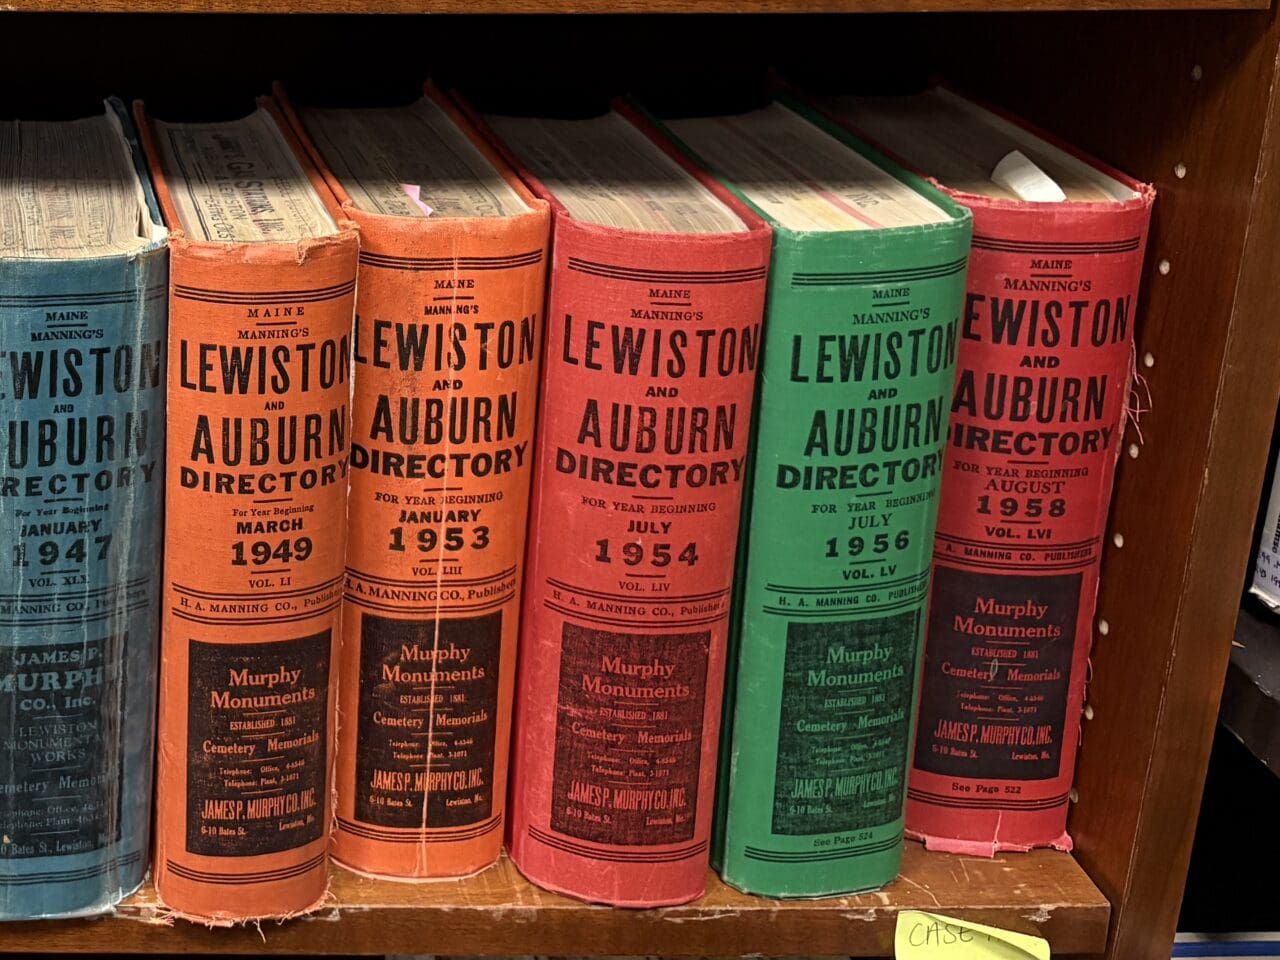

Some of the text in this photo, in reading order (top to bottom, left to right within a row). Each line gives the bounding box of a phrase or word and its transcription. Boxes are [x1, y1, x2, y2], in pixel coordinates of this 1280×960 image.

[631, 309, 703, 321] MANNING'S
[354, 314, 536, 372] LEWISTON
[790, 318, 960, 384] LEWISTON
[951, 368, 1107, 423] AUBURN
[984, 479, 1066, 494] AUGUST
[399, 509, 481, 523] JANUARY
[977, 495, 1065, 517] 1958
[237, 518, 303, 534] MARCH
[628, 520, 671, 534] JULY
[848, 513, 892, 530] JULY
[13, 533, 112, 567] 1947
[389, 526, 489, 552] 1953
[826, 530, 909, 557] 1956
[232, 537, 312, 565] 1949
[596, 539, 699, 567] 1954
[843, 565, 897, 580] VOL. LV
[975, 597, 1048, 619] Murphy
[400, 644, 471, 662] Murphy
[582, 674, 689, 701] Monuments
[210, 686, 316, 712] Monuments
[203, 731, 318, 756] Cemetery Memorials
[31, 748, 86, 763] WORKS
[952, 782, 1021, 794] See Page 522
